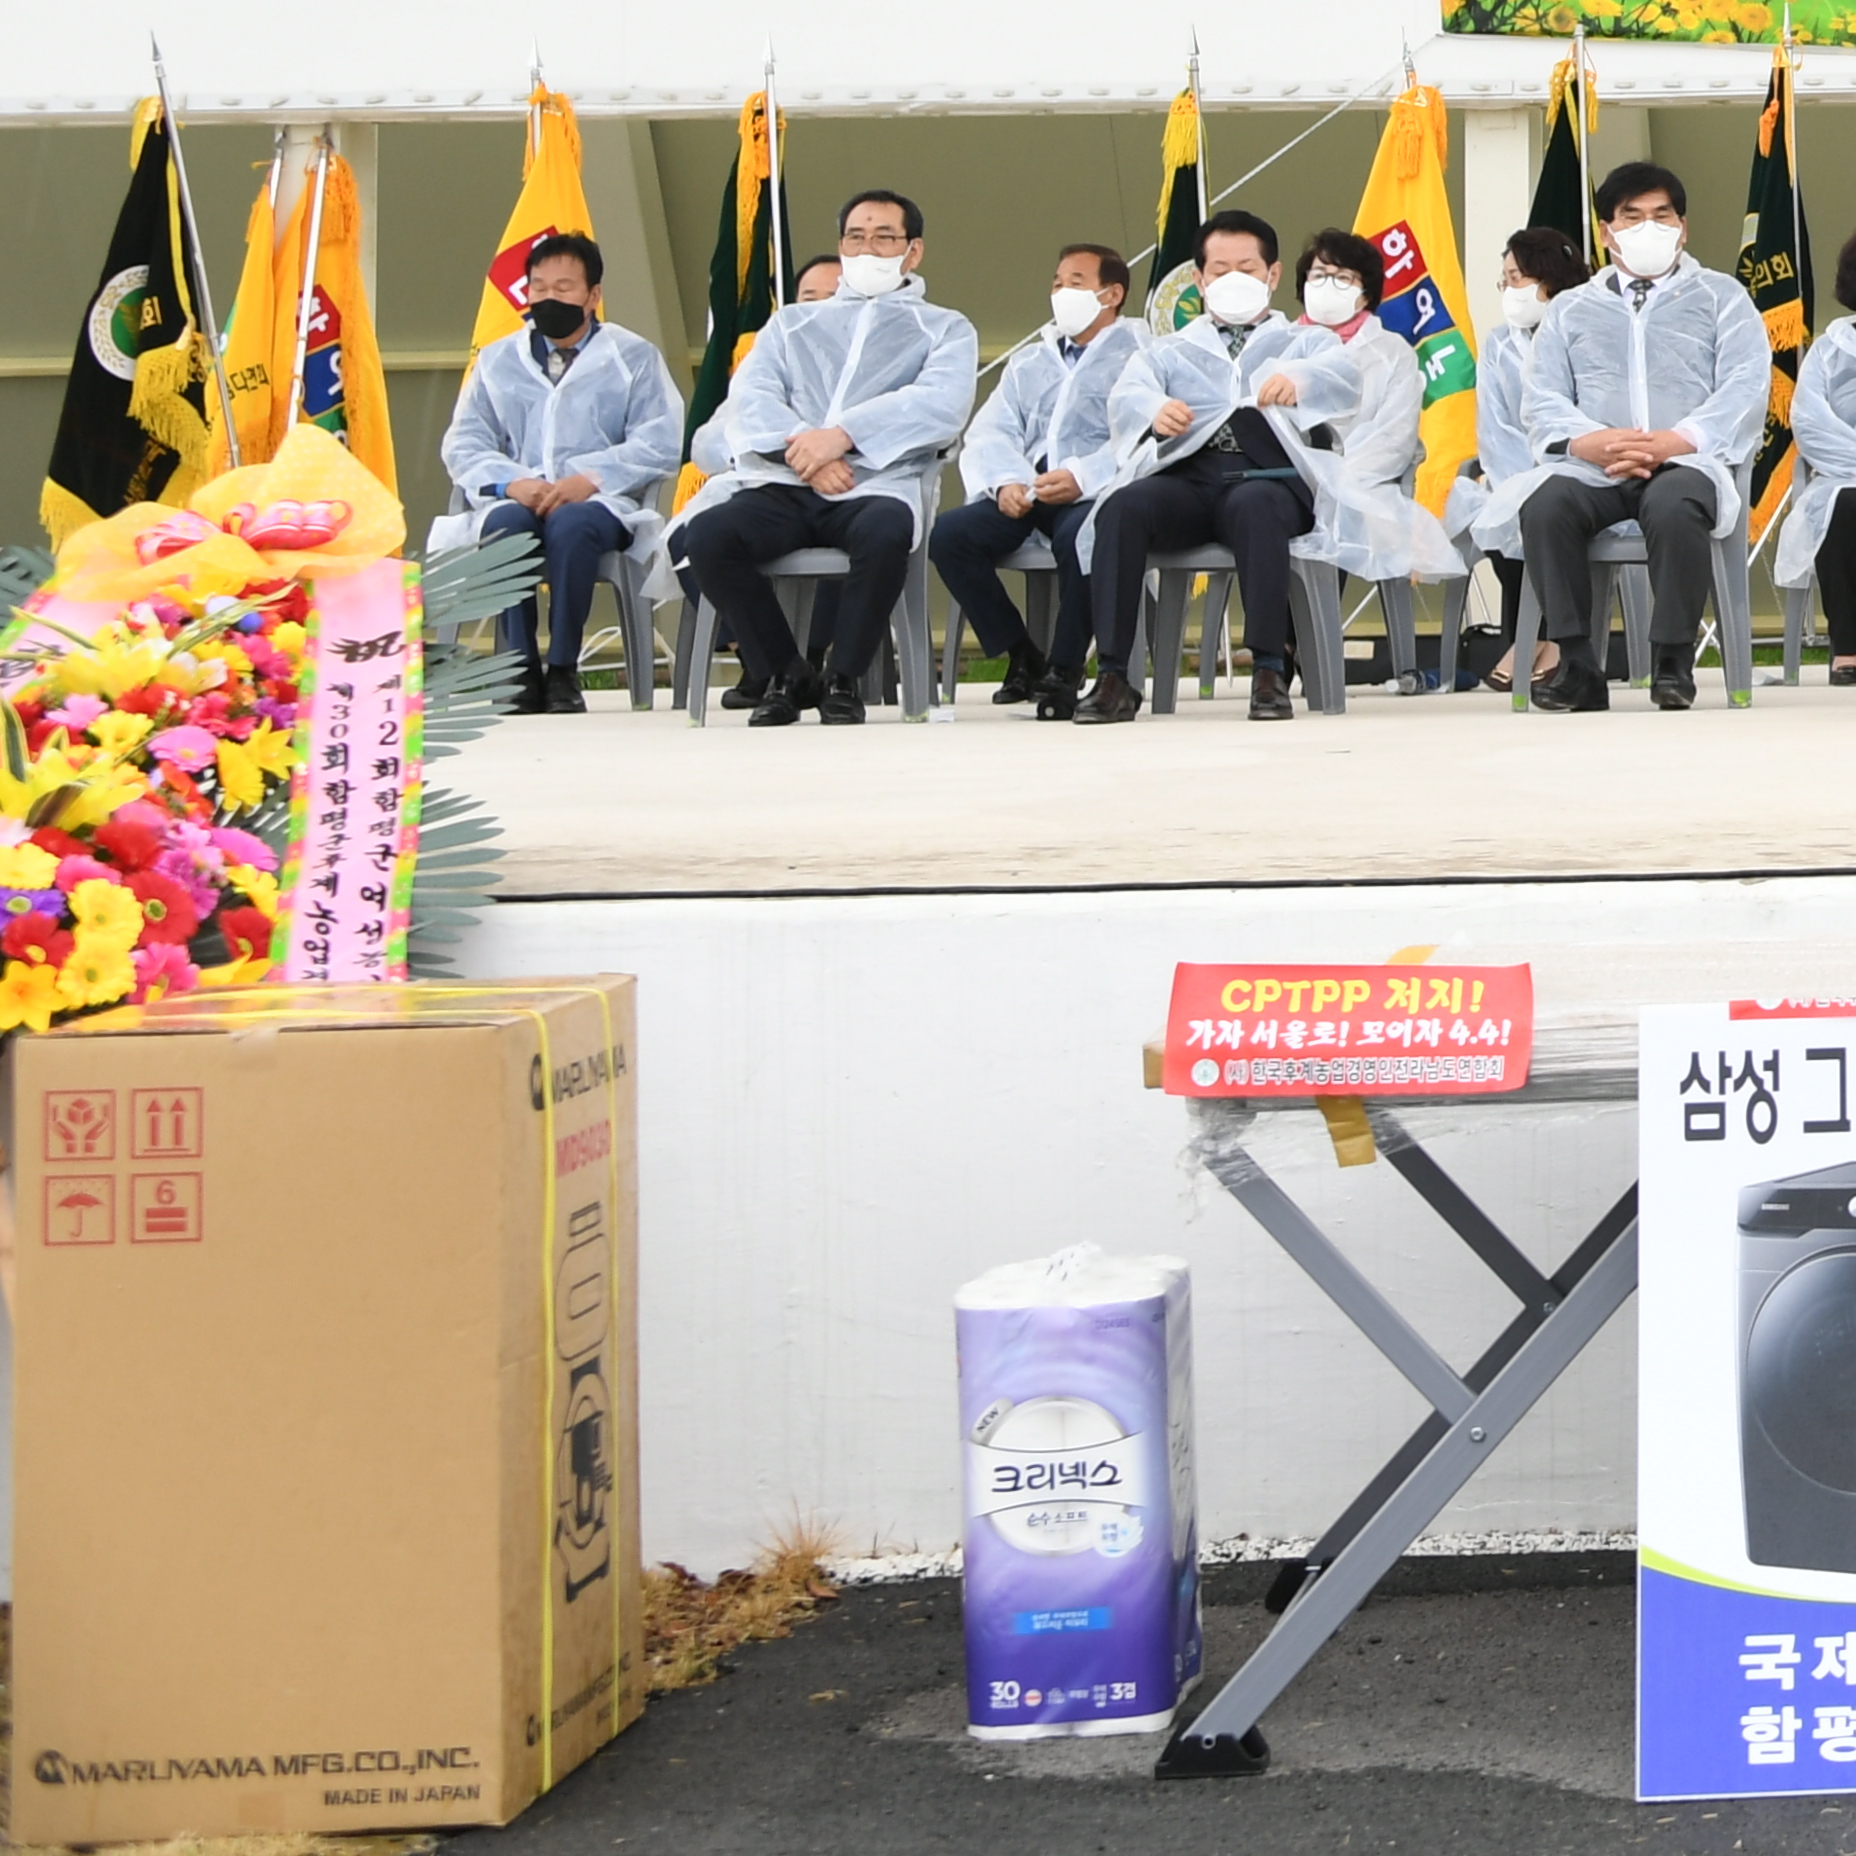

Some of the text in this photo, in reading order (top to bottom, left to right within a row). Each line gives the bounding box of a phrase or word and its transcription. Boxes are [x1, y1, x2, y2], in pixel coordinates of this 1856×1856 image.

[1220, 977, 1485, 1015] CPTPP 저지!
[1186, 1019, 1513, 1051] 가자 서울로! 모이자 4.4!
[1679, 1048, 1782, 1145] 삼성
[976, 1407, 1000, 1434] NEW
[991, 1460, 1125, 1494] 크리넥스
[989, 1680, 1021, 1701] 30
[70, 1755, 269, 1785] MARUYAMA
[324, 1782, 481, 1807] MADE IN JAPAN
